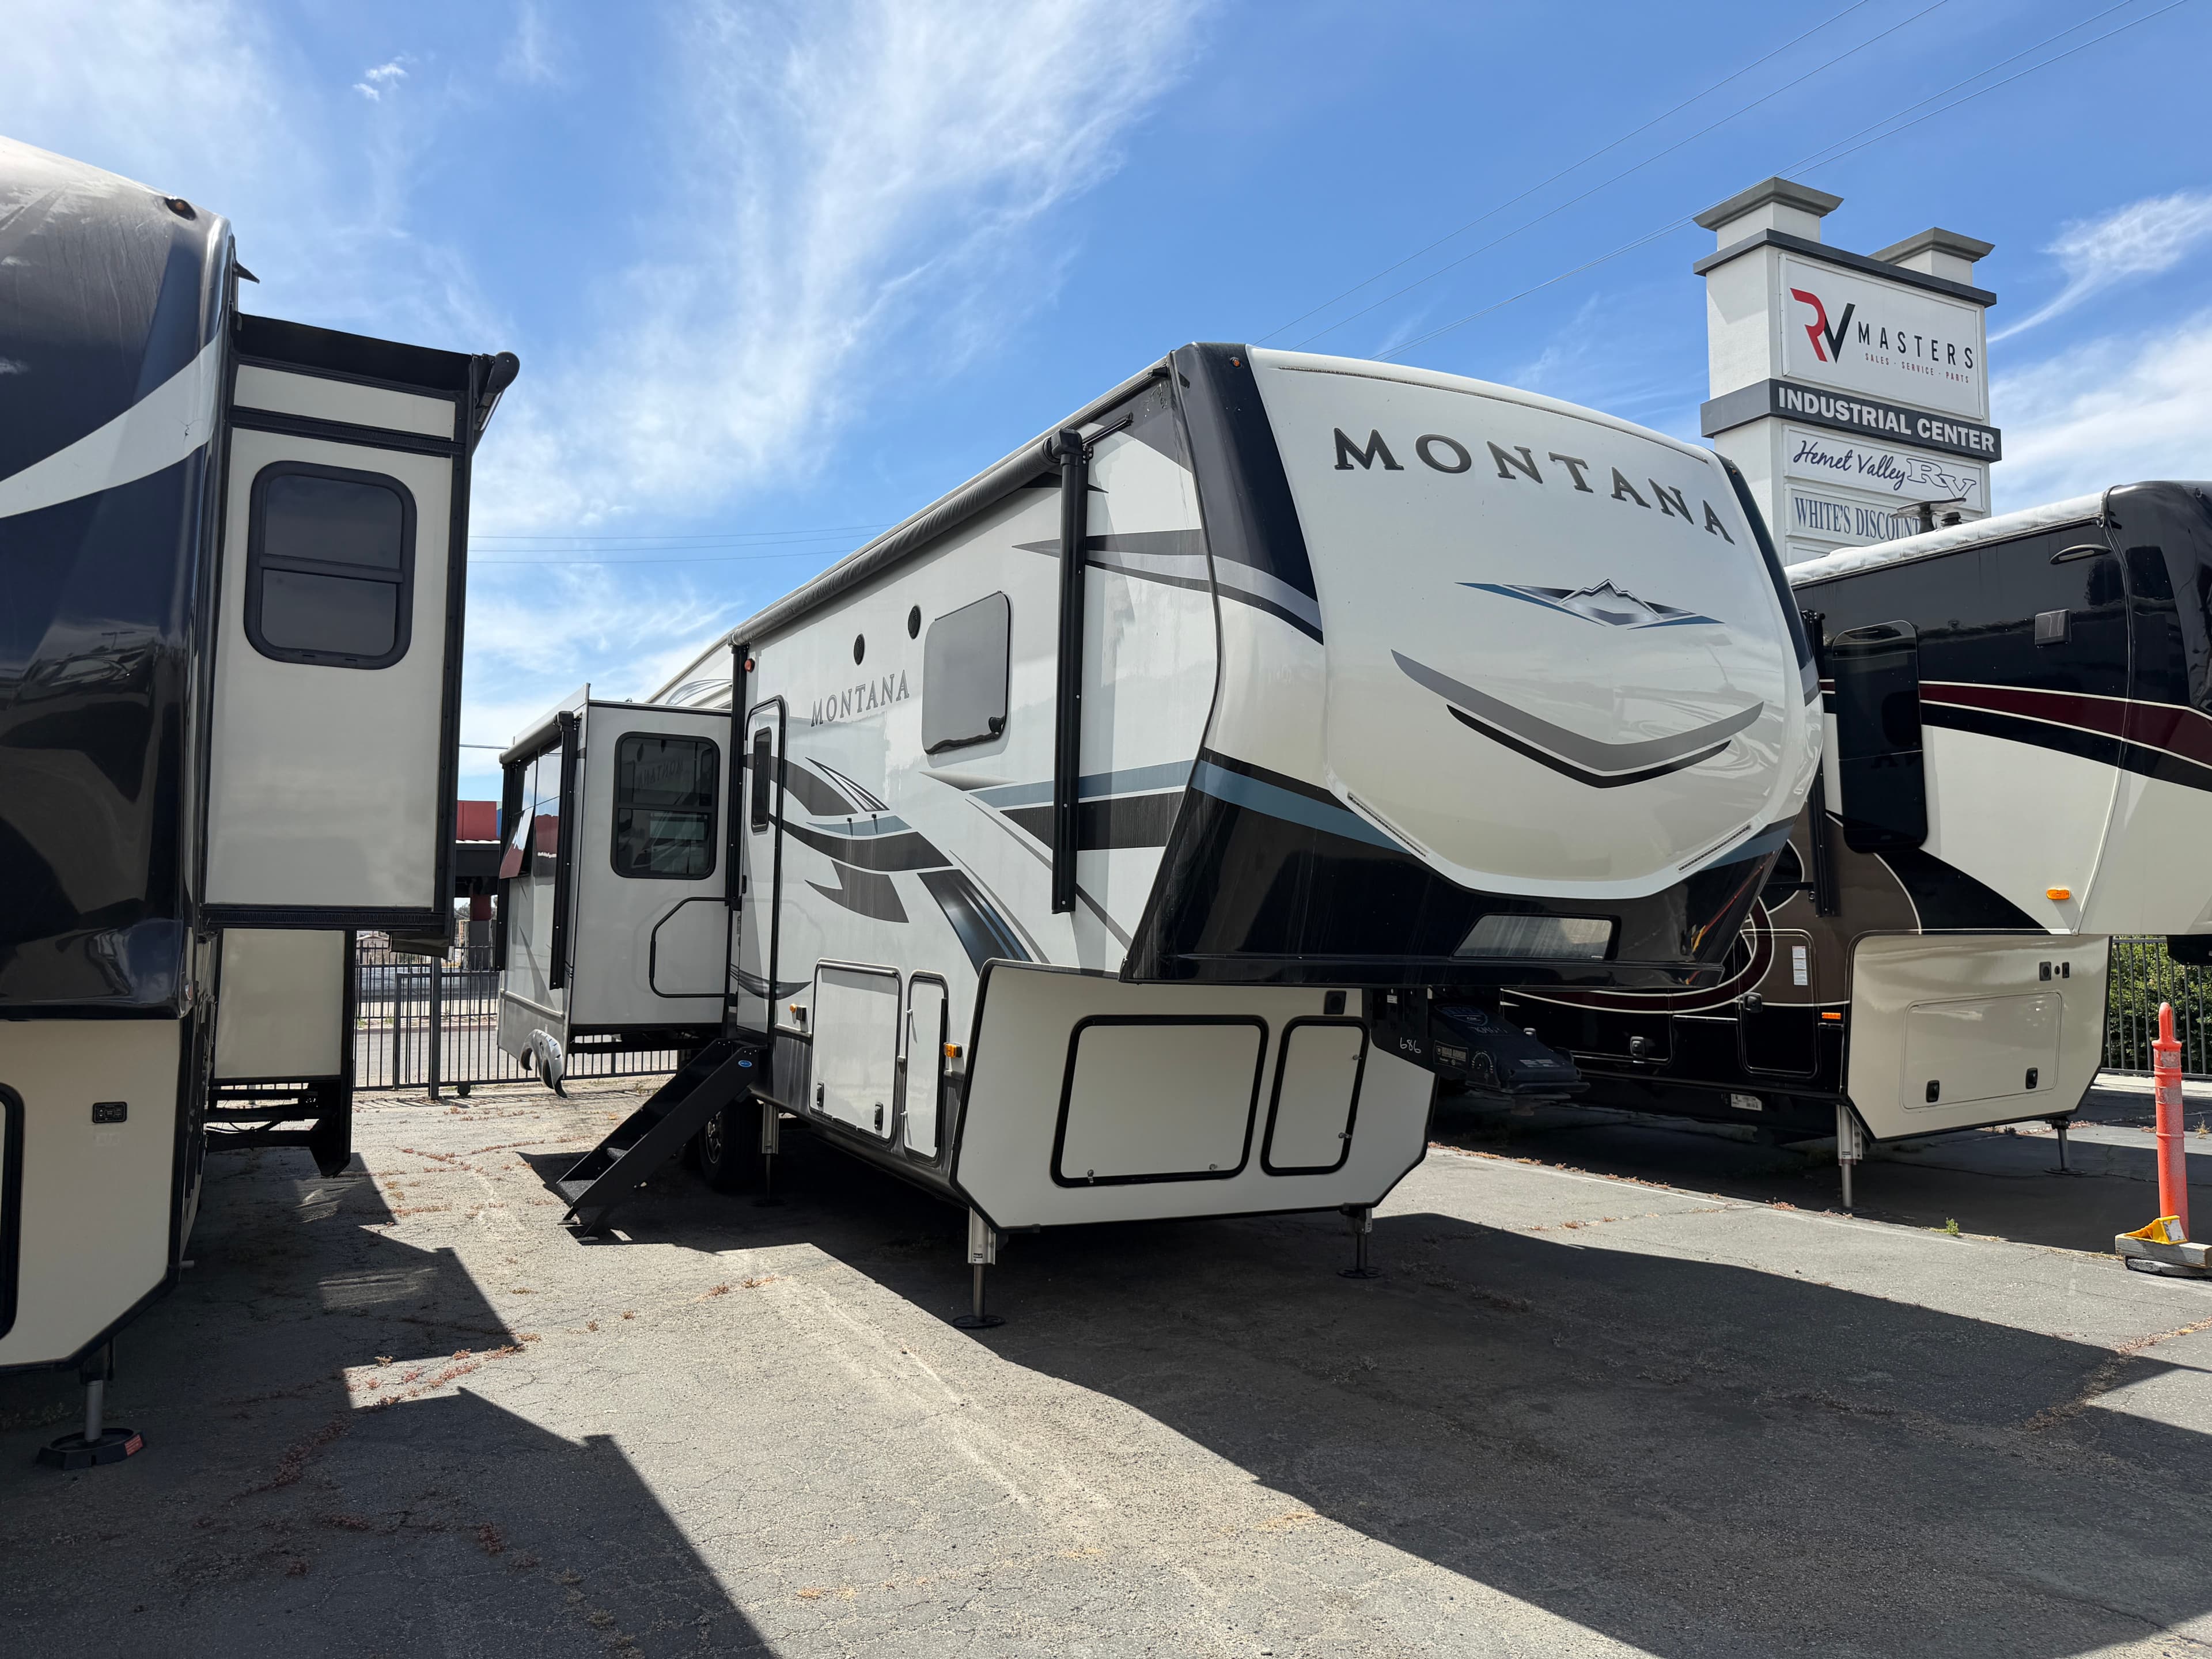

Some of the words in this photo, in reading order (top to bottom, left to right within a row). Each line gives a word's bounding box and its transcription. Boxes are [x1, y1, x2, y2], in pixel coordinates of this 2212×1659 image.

[1790, 287, 1855, 364] RV
[1858, 321, 1974, 369] MASTERS
[1865, 353, 1889, 365] SALES
[1902, 361, 1934, 376] SERVICE
[1946, 372, 1969, 384] PARTS
[1778, 387, 1911, 435] INDUSTRIAL
[1917, 418, 1994, 452] CENTER
[1334, 427, 1734, 545] MONTANA
[1793, 440, 1853, 471] Hemet
[1858, 454, 1906, 491] Valley
[1906, 458, 1977, 498] RV
[1795, 497, 1851, 534] WHITE'S
[811, 669, 910, 727] MONTANA
[1400, 1037, 1421, 1054] 686
